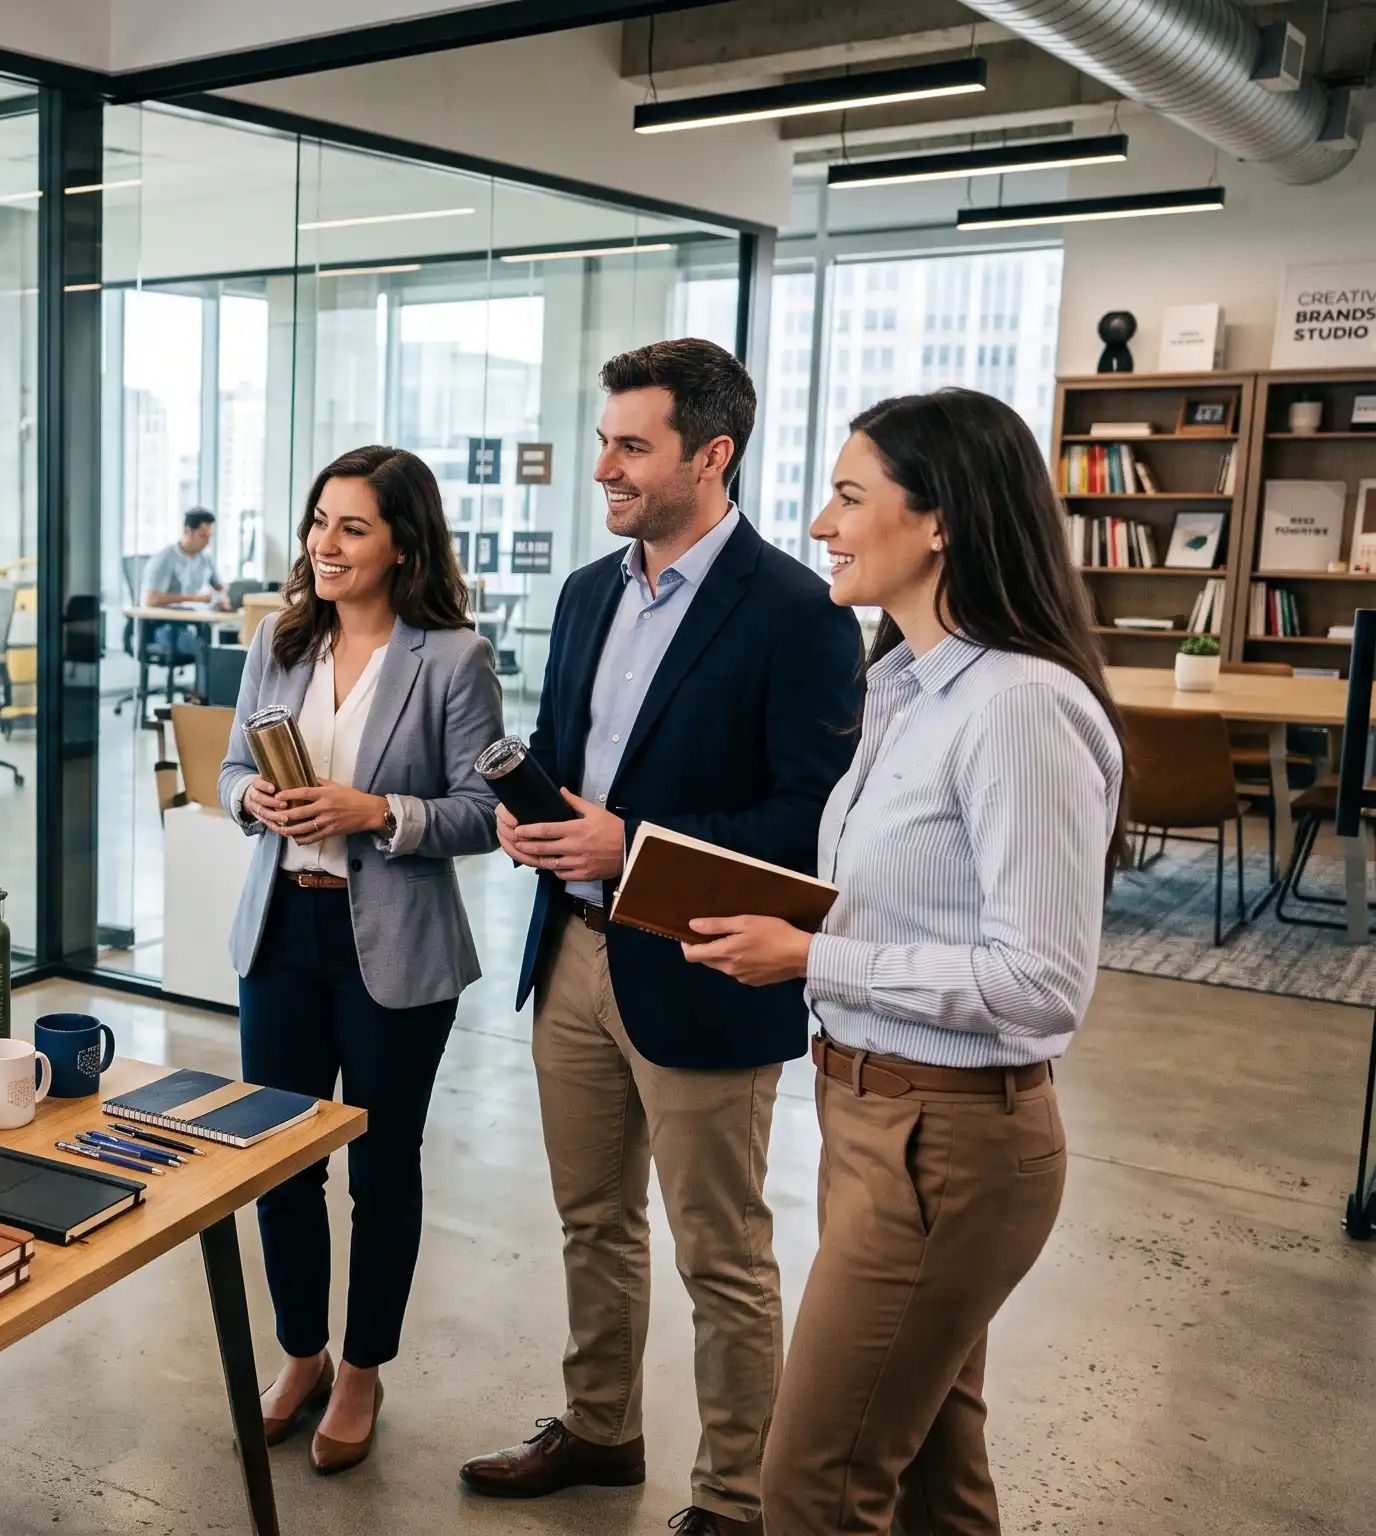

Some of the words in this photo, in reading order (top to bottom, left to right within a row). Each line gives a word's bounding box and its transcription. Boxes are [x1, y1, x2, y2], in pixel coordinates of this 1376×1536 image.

[1297, 288, 1376, 307] CREATIV
[1295, 307, 1376, 324] BRANDS
[1293, 325, 1369, 341] STUDIO
